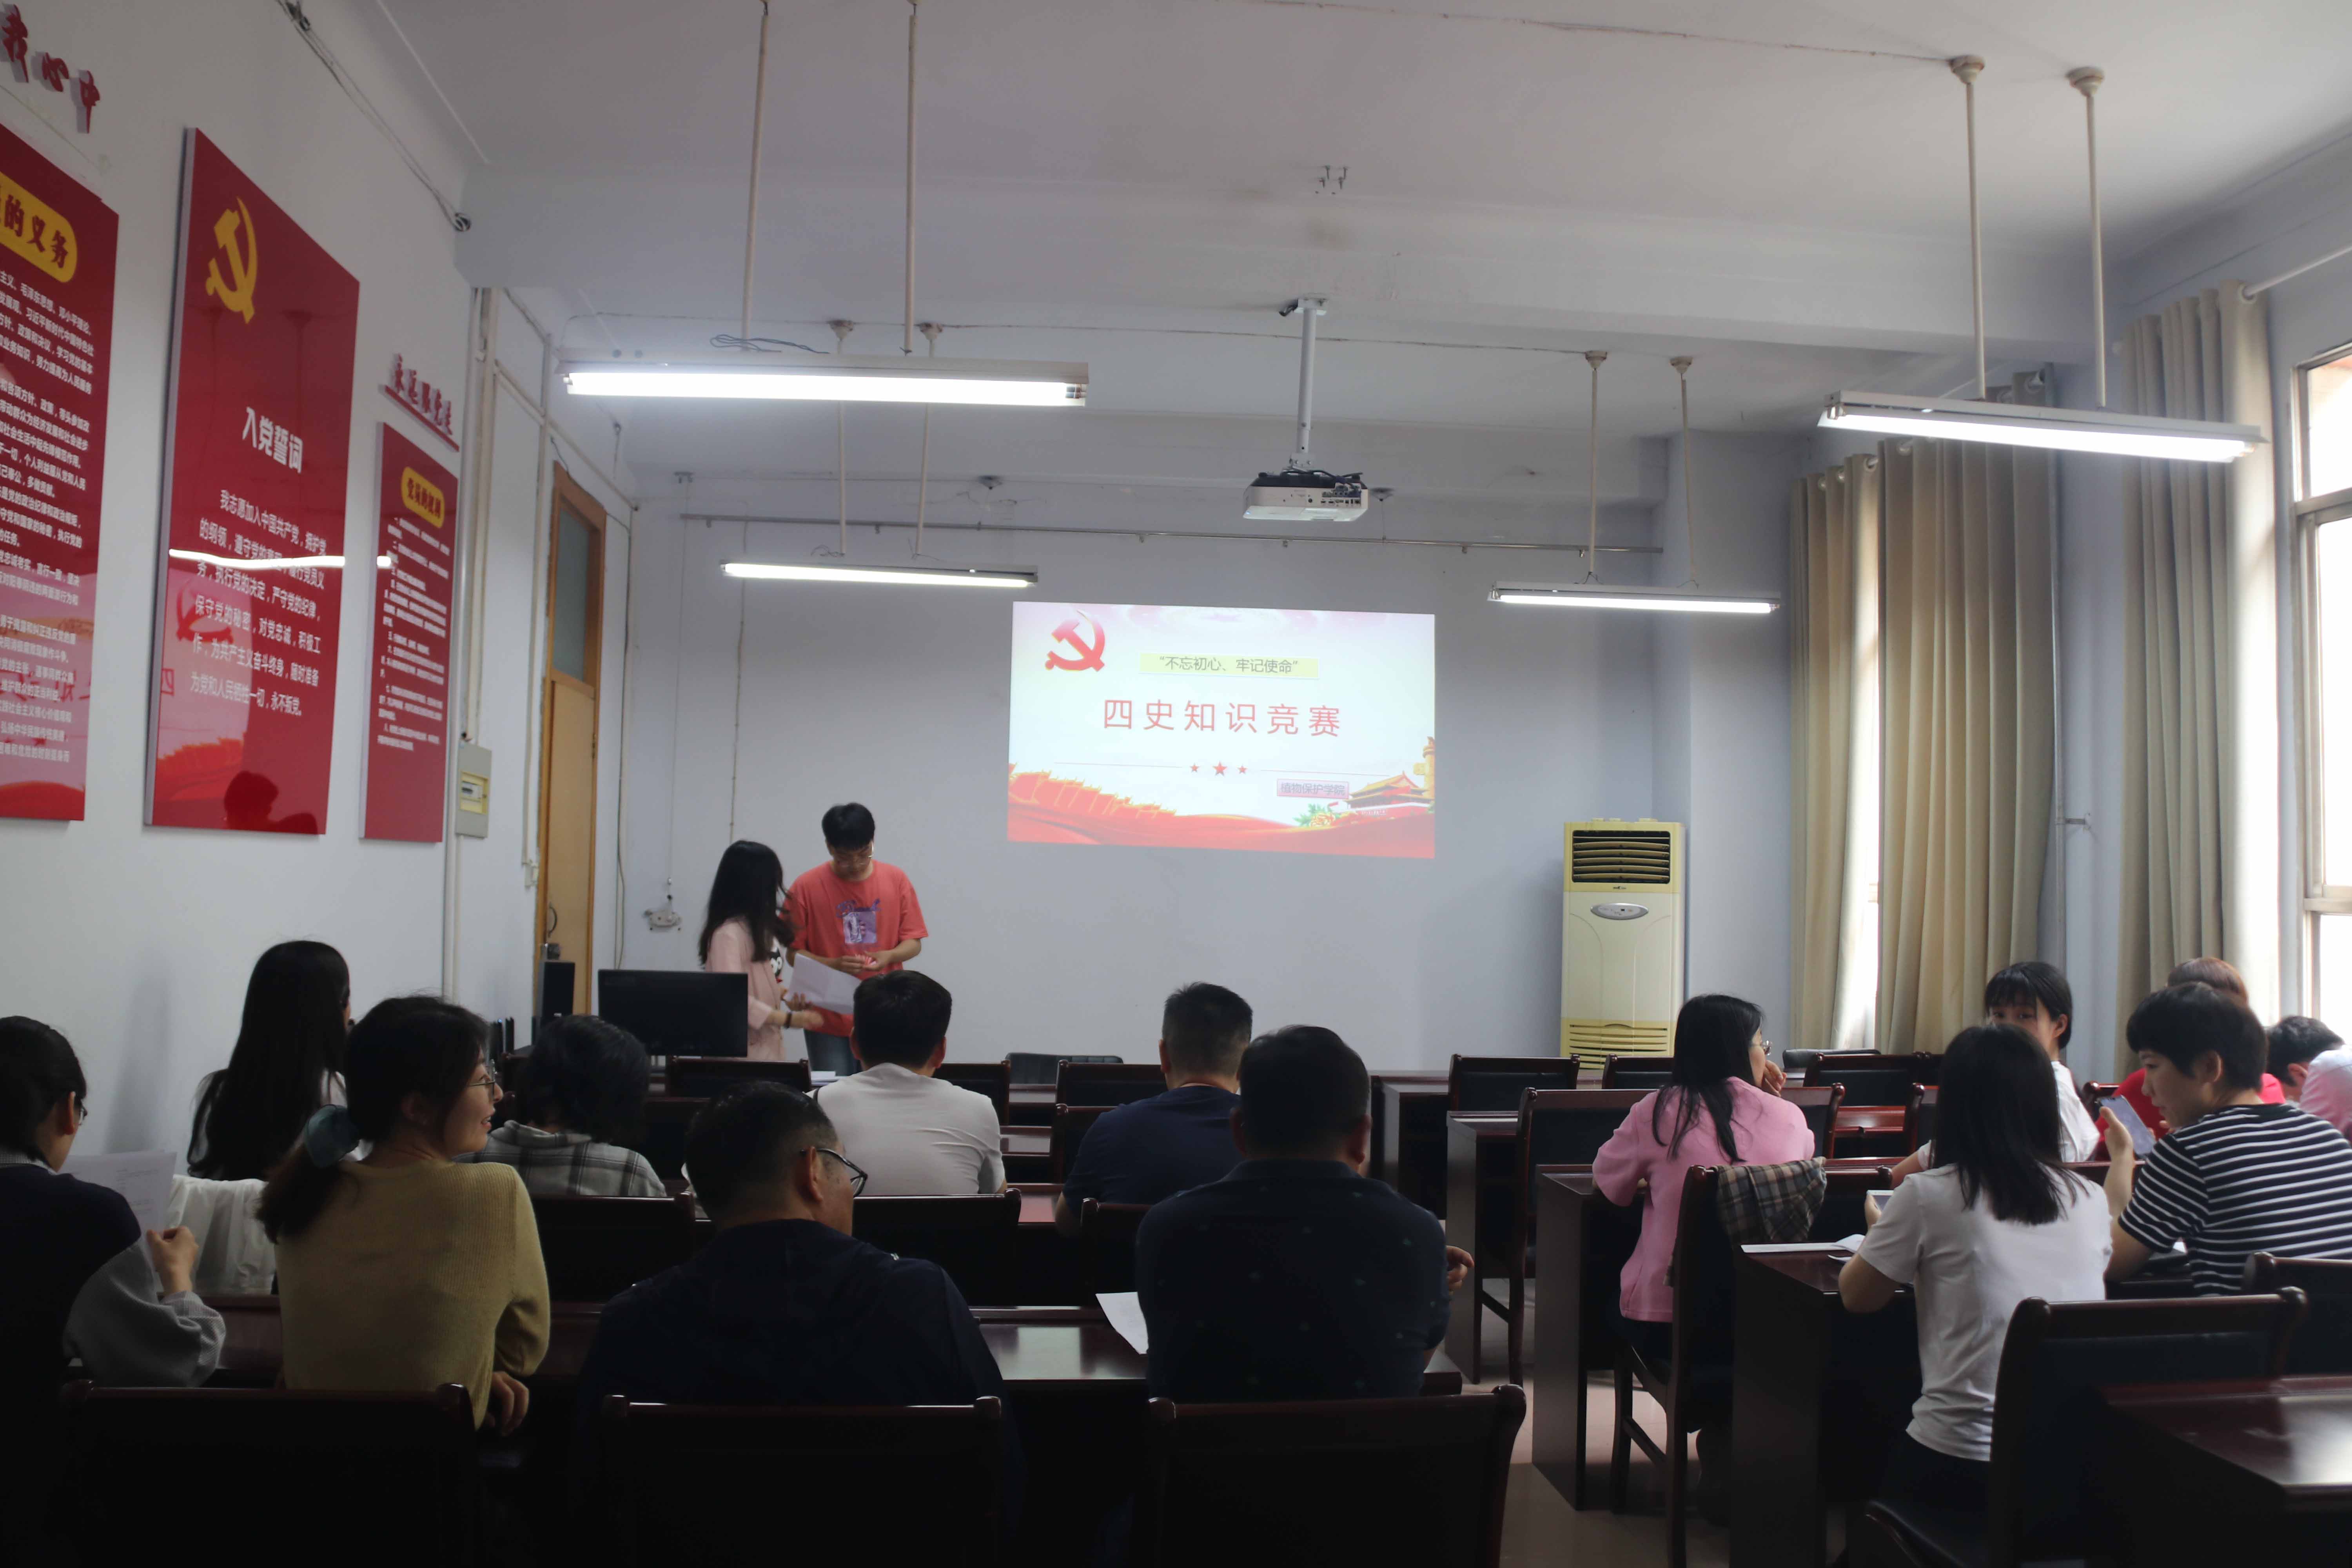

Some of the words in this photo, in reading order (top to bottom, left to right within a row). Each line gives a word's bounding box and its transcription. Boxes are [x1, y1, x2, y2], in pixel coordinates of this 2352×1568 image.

[242, 406, 303, 474] 入党誓词
[220, 490, 327, 556] 我志愿加入中国共产党，拥护党
[195, 595, 321, 654] 保守党的秘密，对党忠诚，积极工
[1159, 656, 1298, 674] “不忘初心、牢记使命”
[190, 671, 302, 716] 为党和人民牺牲一切，永不叛党。
[1103, 699, 1340, 737] 四史知识竞赛
[1281, 782, 1345, 796] 植物保护学院
